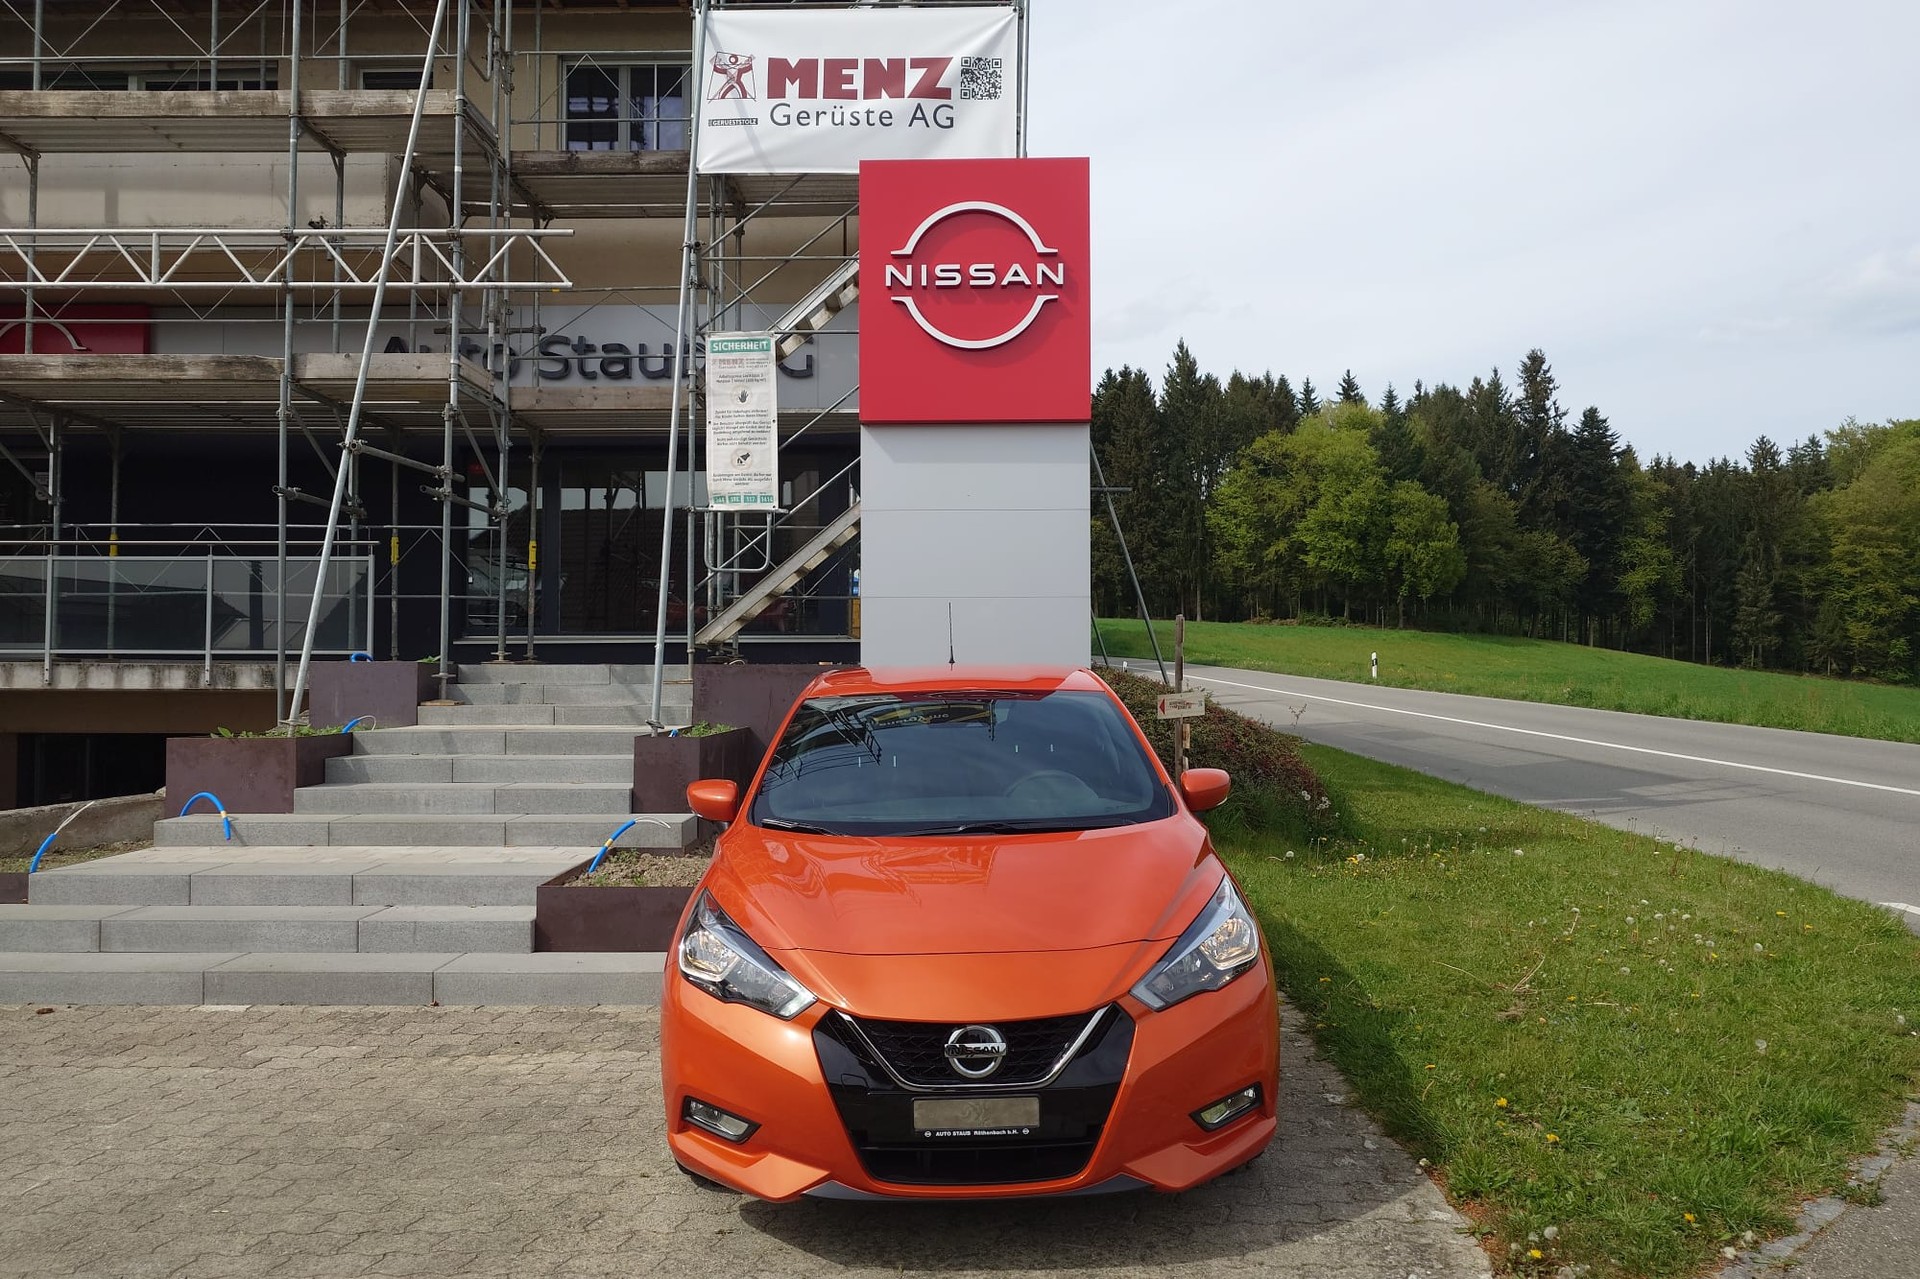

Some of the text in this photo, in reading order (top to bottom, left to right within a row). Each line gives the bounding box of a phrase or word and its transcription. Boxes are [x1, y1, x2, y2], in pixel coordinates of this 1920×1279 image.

[767, 56, 954, 100] MENZ
[769, 103, 955, 129] Gerüste AG
[885, 262, 1064, 288] NISSAN
[712, 341, 768, 351] SICHERHEIT
[948, 1045, 1000, 1055] NISSAN
